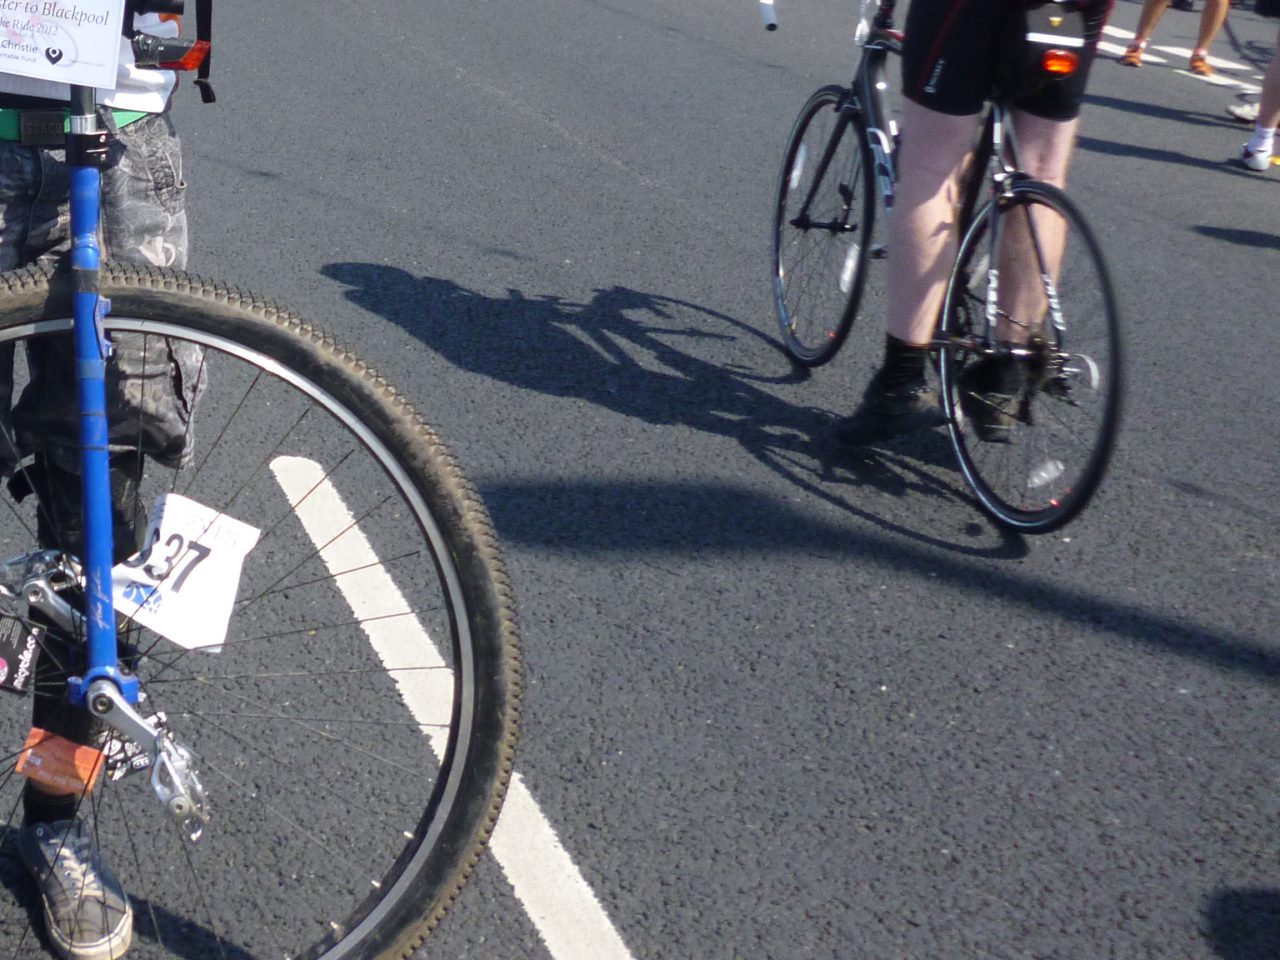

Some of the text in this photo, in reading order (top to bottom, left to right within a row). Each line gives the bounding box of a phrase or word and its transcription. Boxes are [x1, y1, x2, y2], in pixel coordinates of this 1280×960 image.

[24, 3, 39, 14] to
[42, 1, 110, 26] Blackpool
[12, 19, 35, 32] Ride
[36, 23, 59, 36] 2012
[1, 39, 39, 54] Christie
[21, 54, 37, 63] Fund
